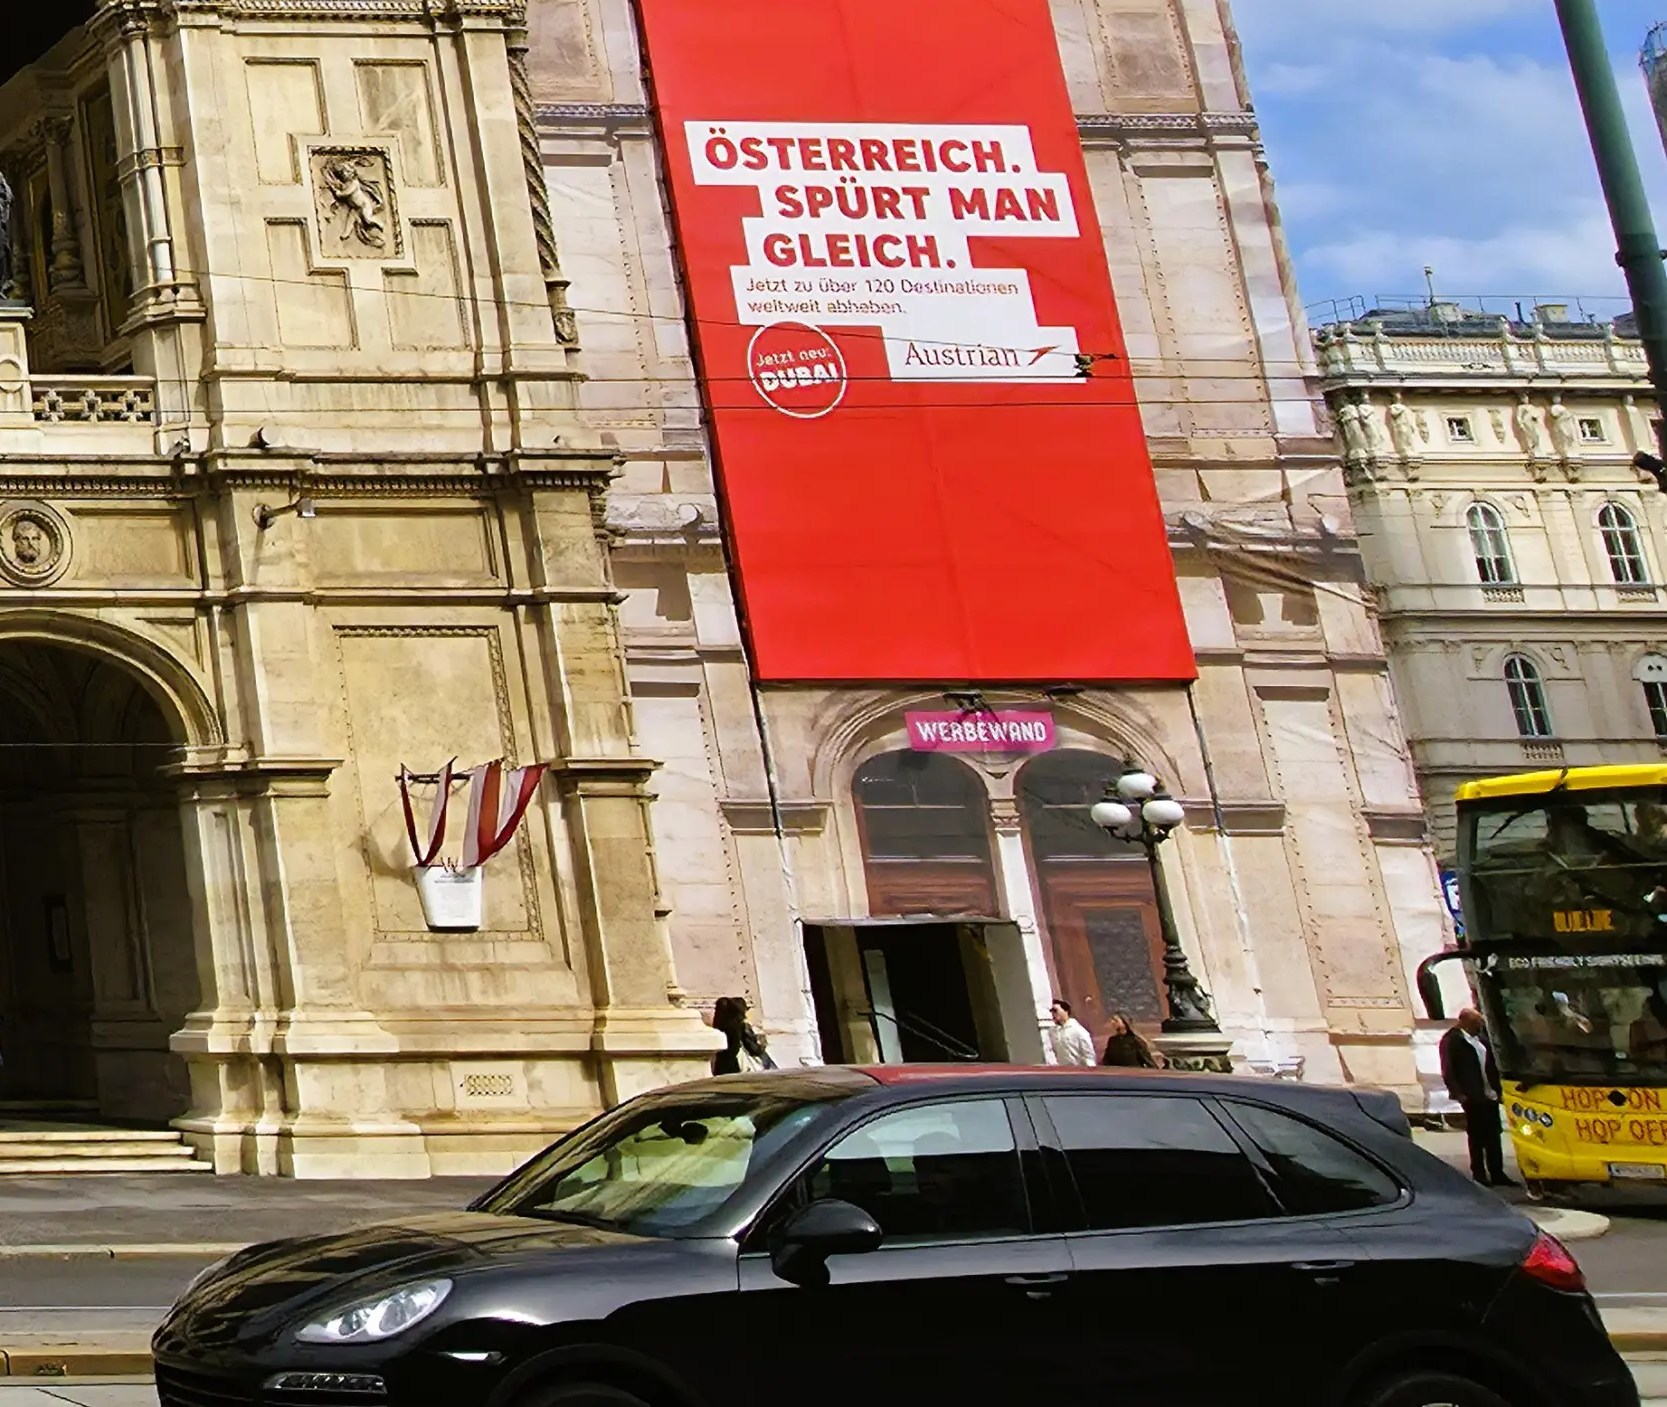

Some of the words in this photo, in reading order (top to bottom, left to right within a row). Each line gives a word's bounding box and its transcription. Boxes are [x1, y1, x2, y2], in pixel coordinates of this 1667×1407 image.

[705, 127, 1022, 174] ÖSTERREICH.
[774, 176, 931, 220] SPÜRT
[948, 187, 1061, 222] MAN
[762, 233, 957, 269] GLEICH.
[746, 278, 788, 293] Jetzt
[794, 280, 813, 293] zu
[819, 278, 857, 293] über
[866, 278, 895, 293] 120
[900, 279, 1019, 295] Destinationen
[756, 350, 795, 367] Jetzt
[904, 342, 1022, 367] Austrian
[759, 362, 840, 392] DUBAI
[915, 721, 1047, 742] WERBEWAND
[1560, 1088, 1606, 1110] HOP
[1627, 1087, 1661, 1110] ON
[1575, 1118, 1621, 1143] HOP
